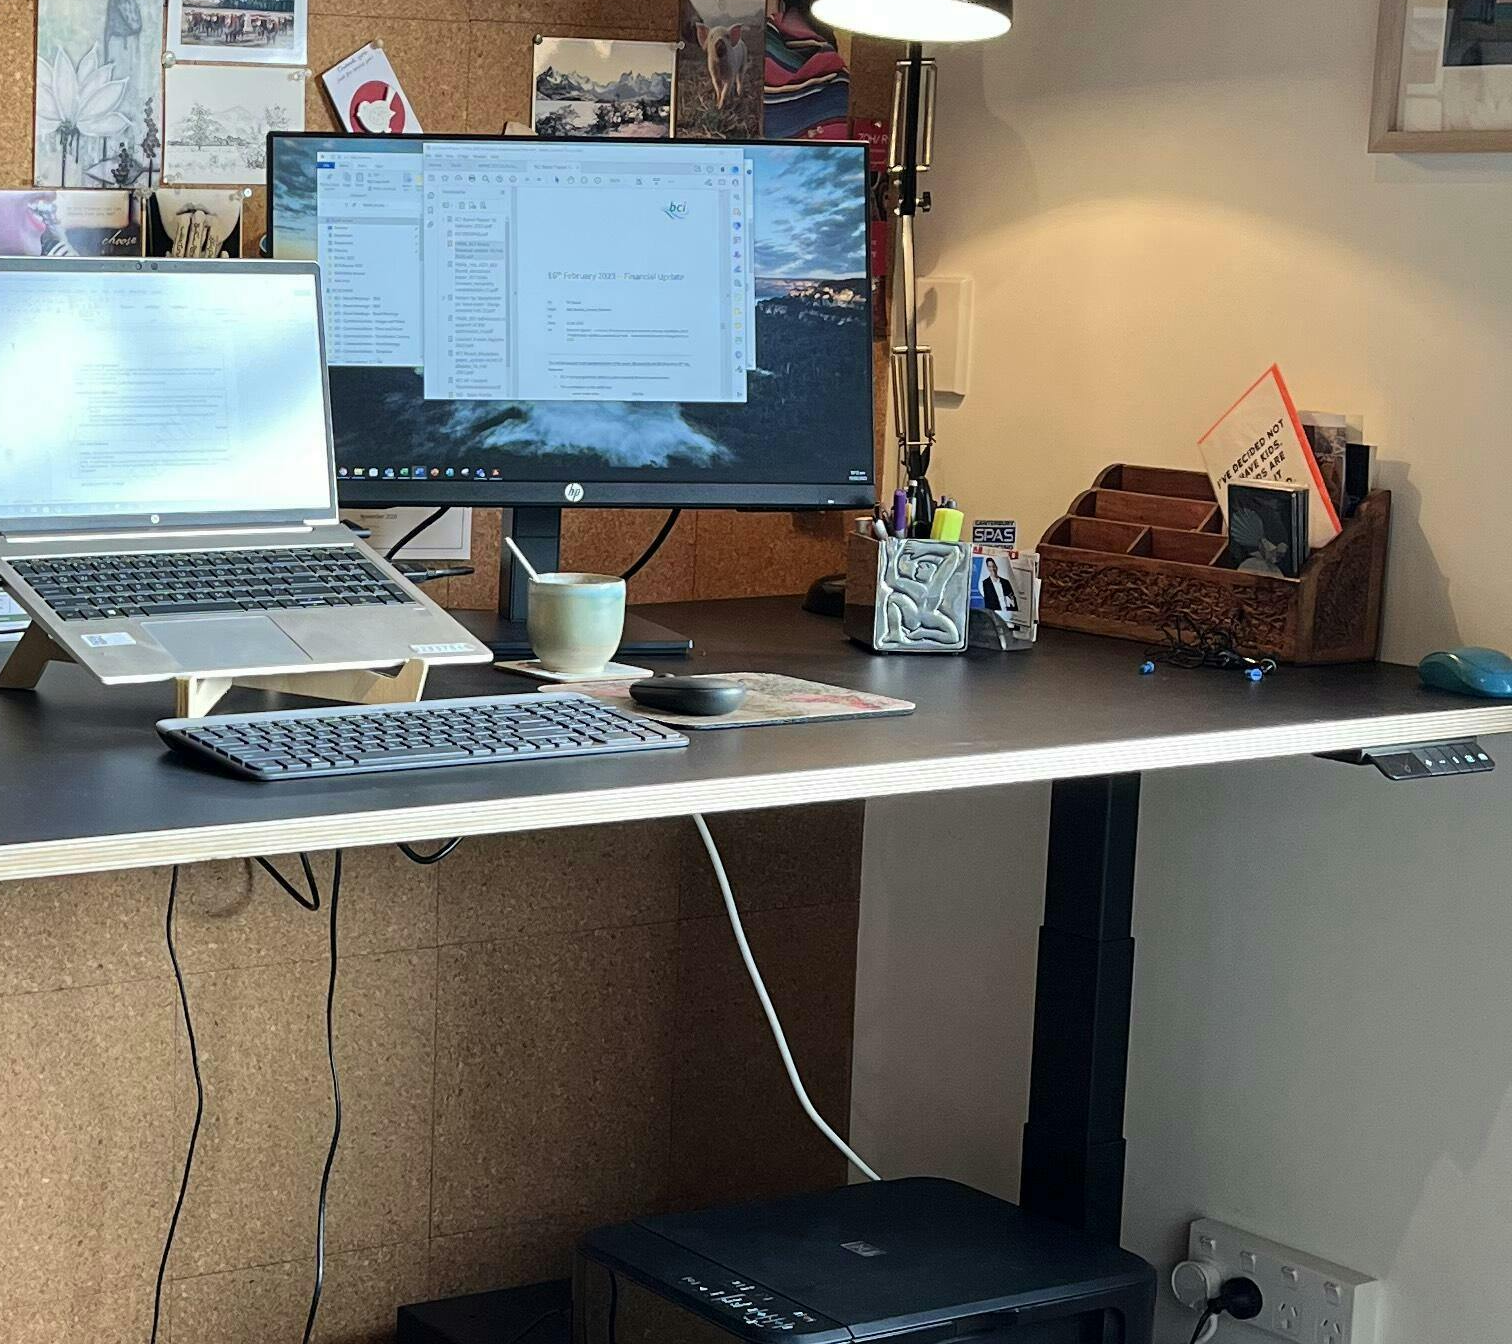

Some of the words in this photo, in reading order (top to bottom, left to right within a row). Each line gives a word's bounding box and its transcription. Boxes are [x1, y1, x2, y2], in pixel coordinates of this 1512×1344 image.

[669, 200, 687, 213] bci
[101, 229, 137, 246] choose
[563, 272, 597, 281] February
[623, 272, 657, 281] Financial
[1216, 469, 1232, 490] I'VE
[1232, 437, 1266, 474] DECIDED
[1266, 418, 1285, 439] NOT
[1269, 451, 1286, 471] ARE
[973, 528, 1015, 542] SPAS
